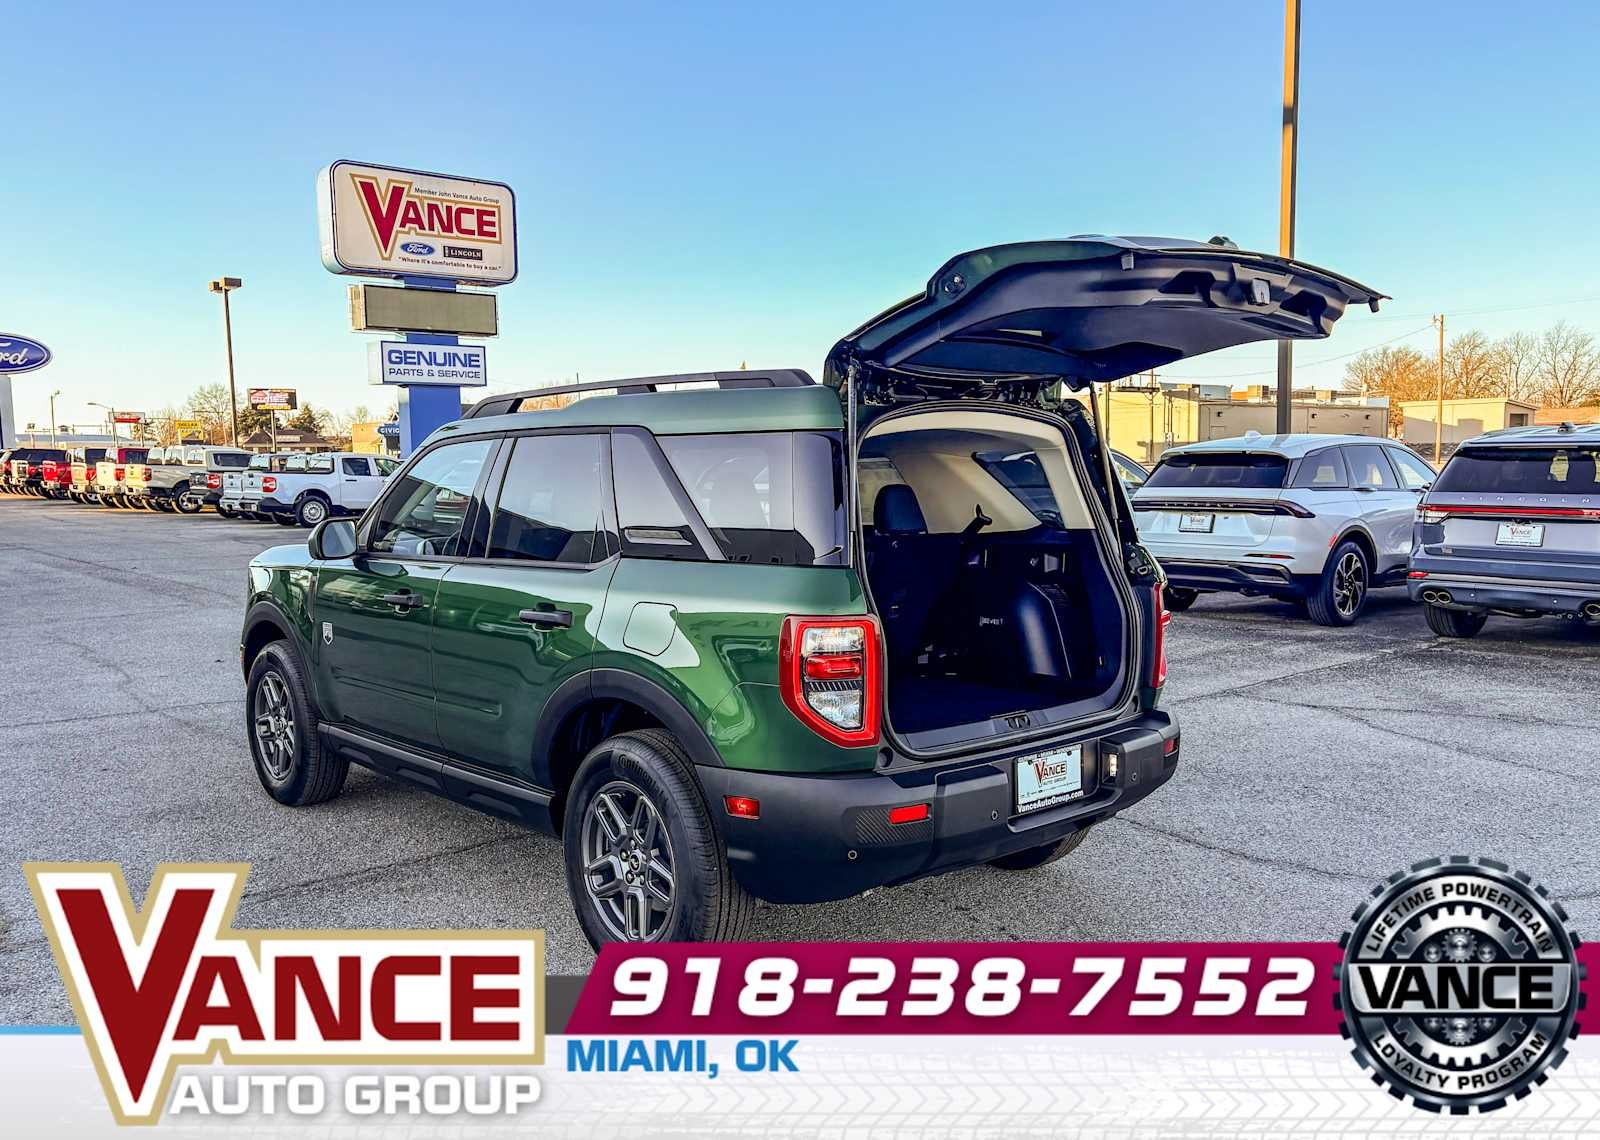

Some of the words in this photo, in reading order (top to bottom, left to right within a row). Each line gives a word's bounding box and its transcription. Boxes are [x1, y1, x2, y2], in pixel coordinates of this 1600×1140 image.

[414, 187, 437, 196] Member
[358, 180, 497, 255] VANCE
[407, 242, 429, 254] Ford
[450, 249, 482, 258] LINCOLN
[431, 259, 466, 267] comfortable
[387, 349, 480, 368] GENUINE
[388, 368, 424, 377] PARTS
[427, 369, 435, 377] &
[437, 370, 480, 379] SERVICE
[1017, 790, 1084, 813] VanceAutoGroup.com
